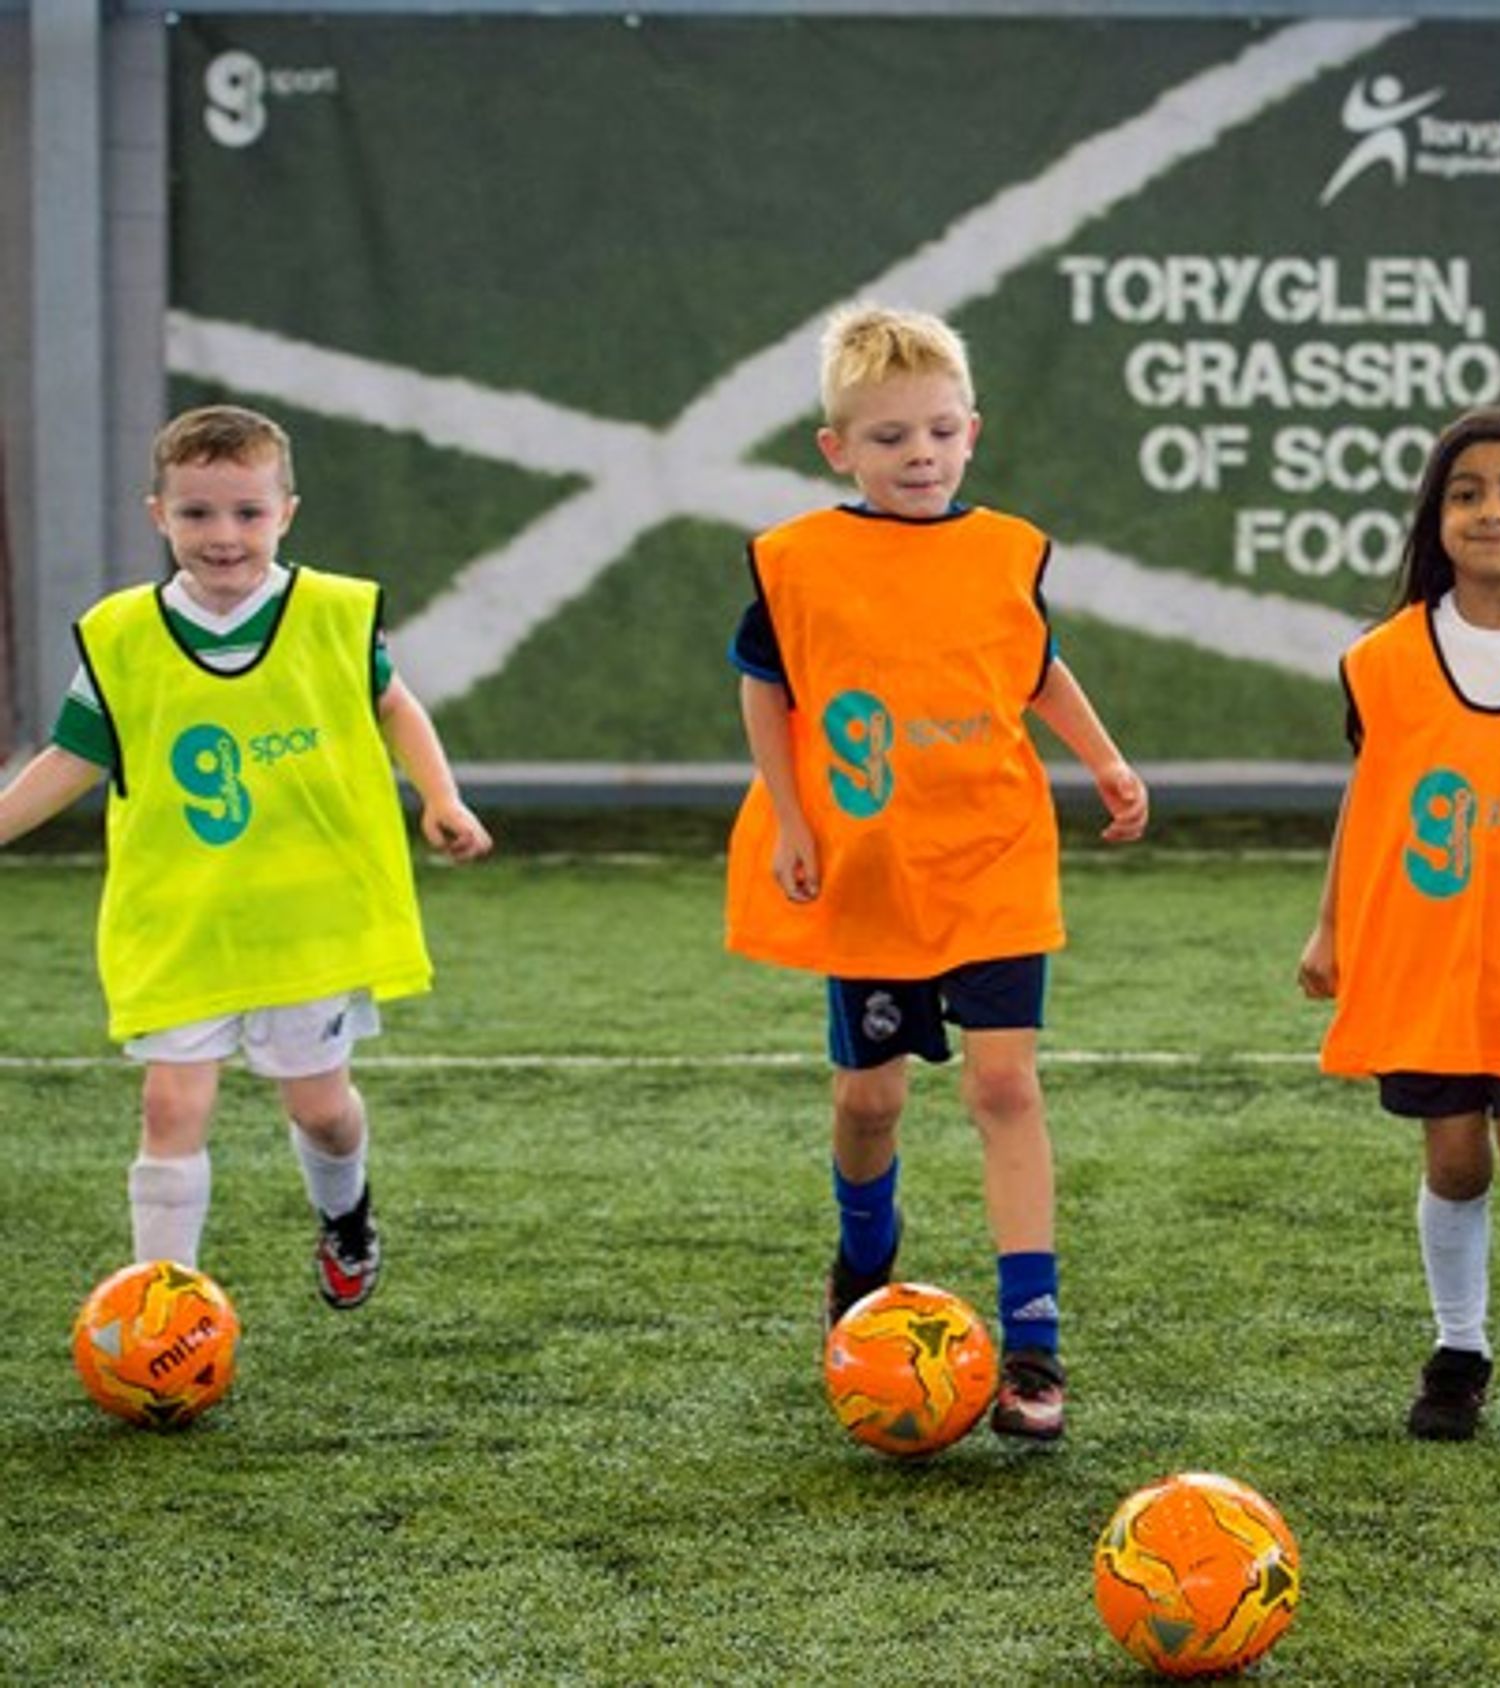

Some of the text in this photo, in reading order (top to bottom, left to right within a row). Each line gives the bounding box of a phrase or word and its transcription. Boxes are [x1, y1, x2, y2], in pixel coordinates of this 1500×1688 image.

[1058, 255, 1484, 338] TORYGLEN,
[1138, 425, 1250, 492] OF
[249, 726, 320, 767] spor
[149, 1315, 213, 1380] mitre
